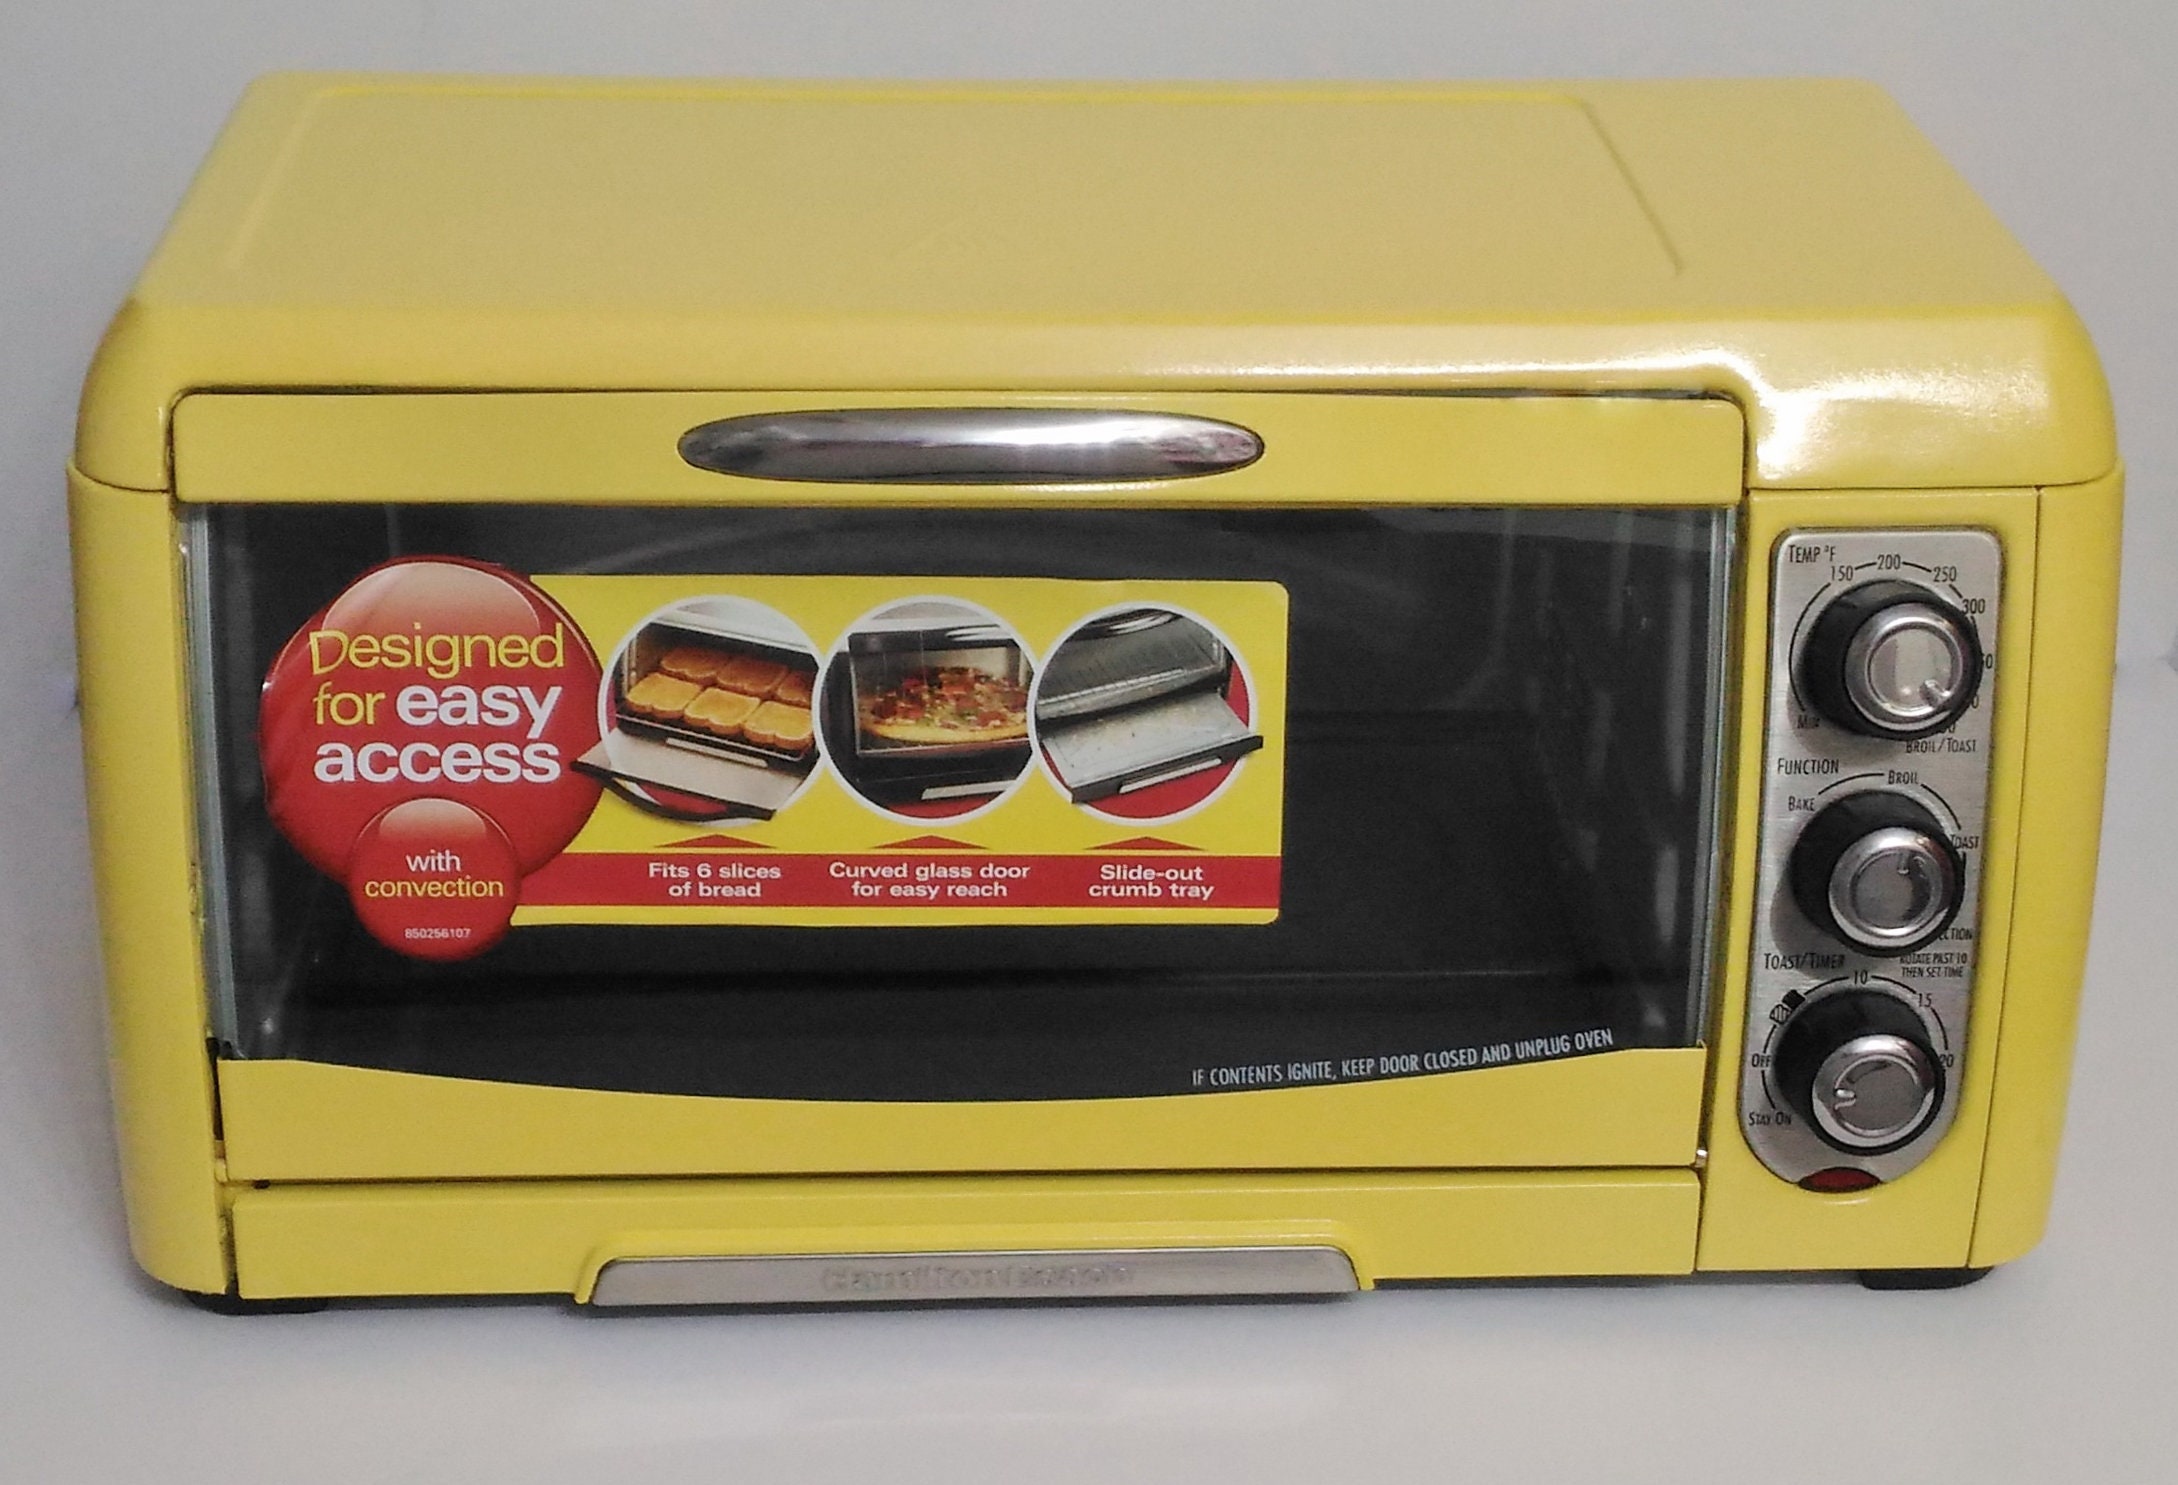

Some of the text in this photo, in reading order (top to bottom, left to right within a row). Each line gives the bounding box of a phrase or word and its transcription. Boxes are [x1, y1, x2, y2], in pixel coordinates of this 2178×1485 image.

[1788, 545, 1820, 563] TEMP
[1877, 555, 1901, 570] 200
[1831, 565, 1854, 581] 150
[1933, 567, 1957, 582] 250
[1962, 600, 1985, 614] 300
[309, 622, 565, 680] Designed
[313, 682, 562, 740] for easy
[314, 742, 561, 784] access
[1778, 758, 1839, 775] FUNCTION
[1888, 770, 1918, 785] BROIL
[1788, 796, 1816, 812] BAKE
[405, 849, 461, 872] with
[648, 862, 781, 880] Fits 6 slices
[829, 862, 1030, 884] Curved glass door
[1100, 864, 1203, 881] Slide-out
[365, 874, 504, 898] convection
[668, 881, 761, 898] of bread
[852, 881, 1008, 900] for easy reach
[1088, 881, 1214, 900] crumb tray
[404, 928, 472, 939] 850256107
[1764, 953, 1846, 970] TOAST/TIMER
[1854, 971, 1868, 984] 10
[1918, 993, 1932, 1007] 15
[1192, 1028, 1614, 1086] IF CONTENTS IGNITE, KEEP DOOR CLOSED AND UNPLUG OVEN
[1752, 1054, 1771, 1067] OFF
[1940, 1054, 1953, 1067] 20
[1749, 1113, 1792, 1126] STAY ON
